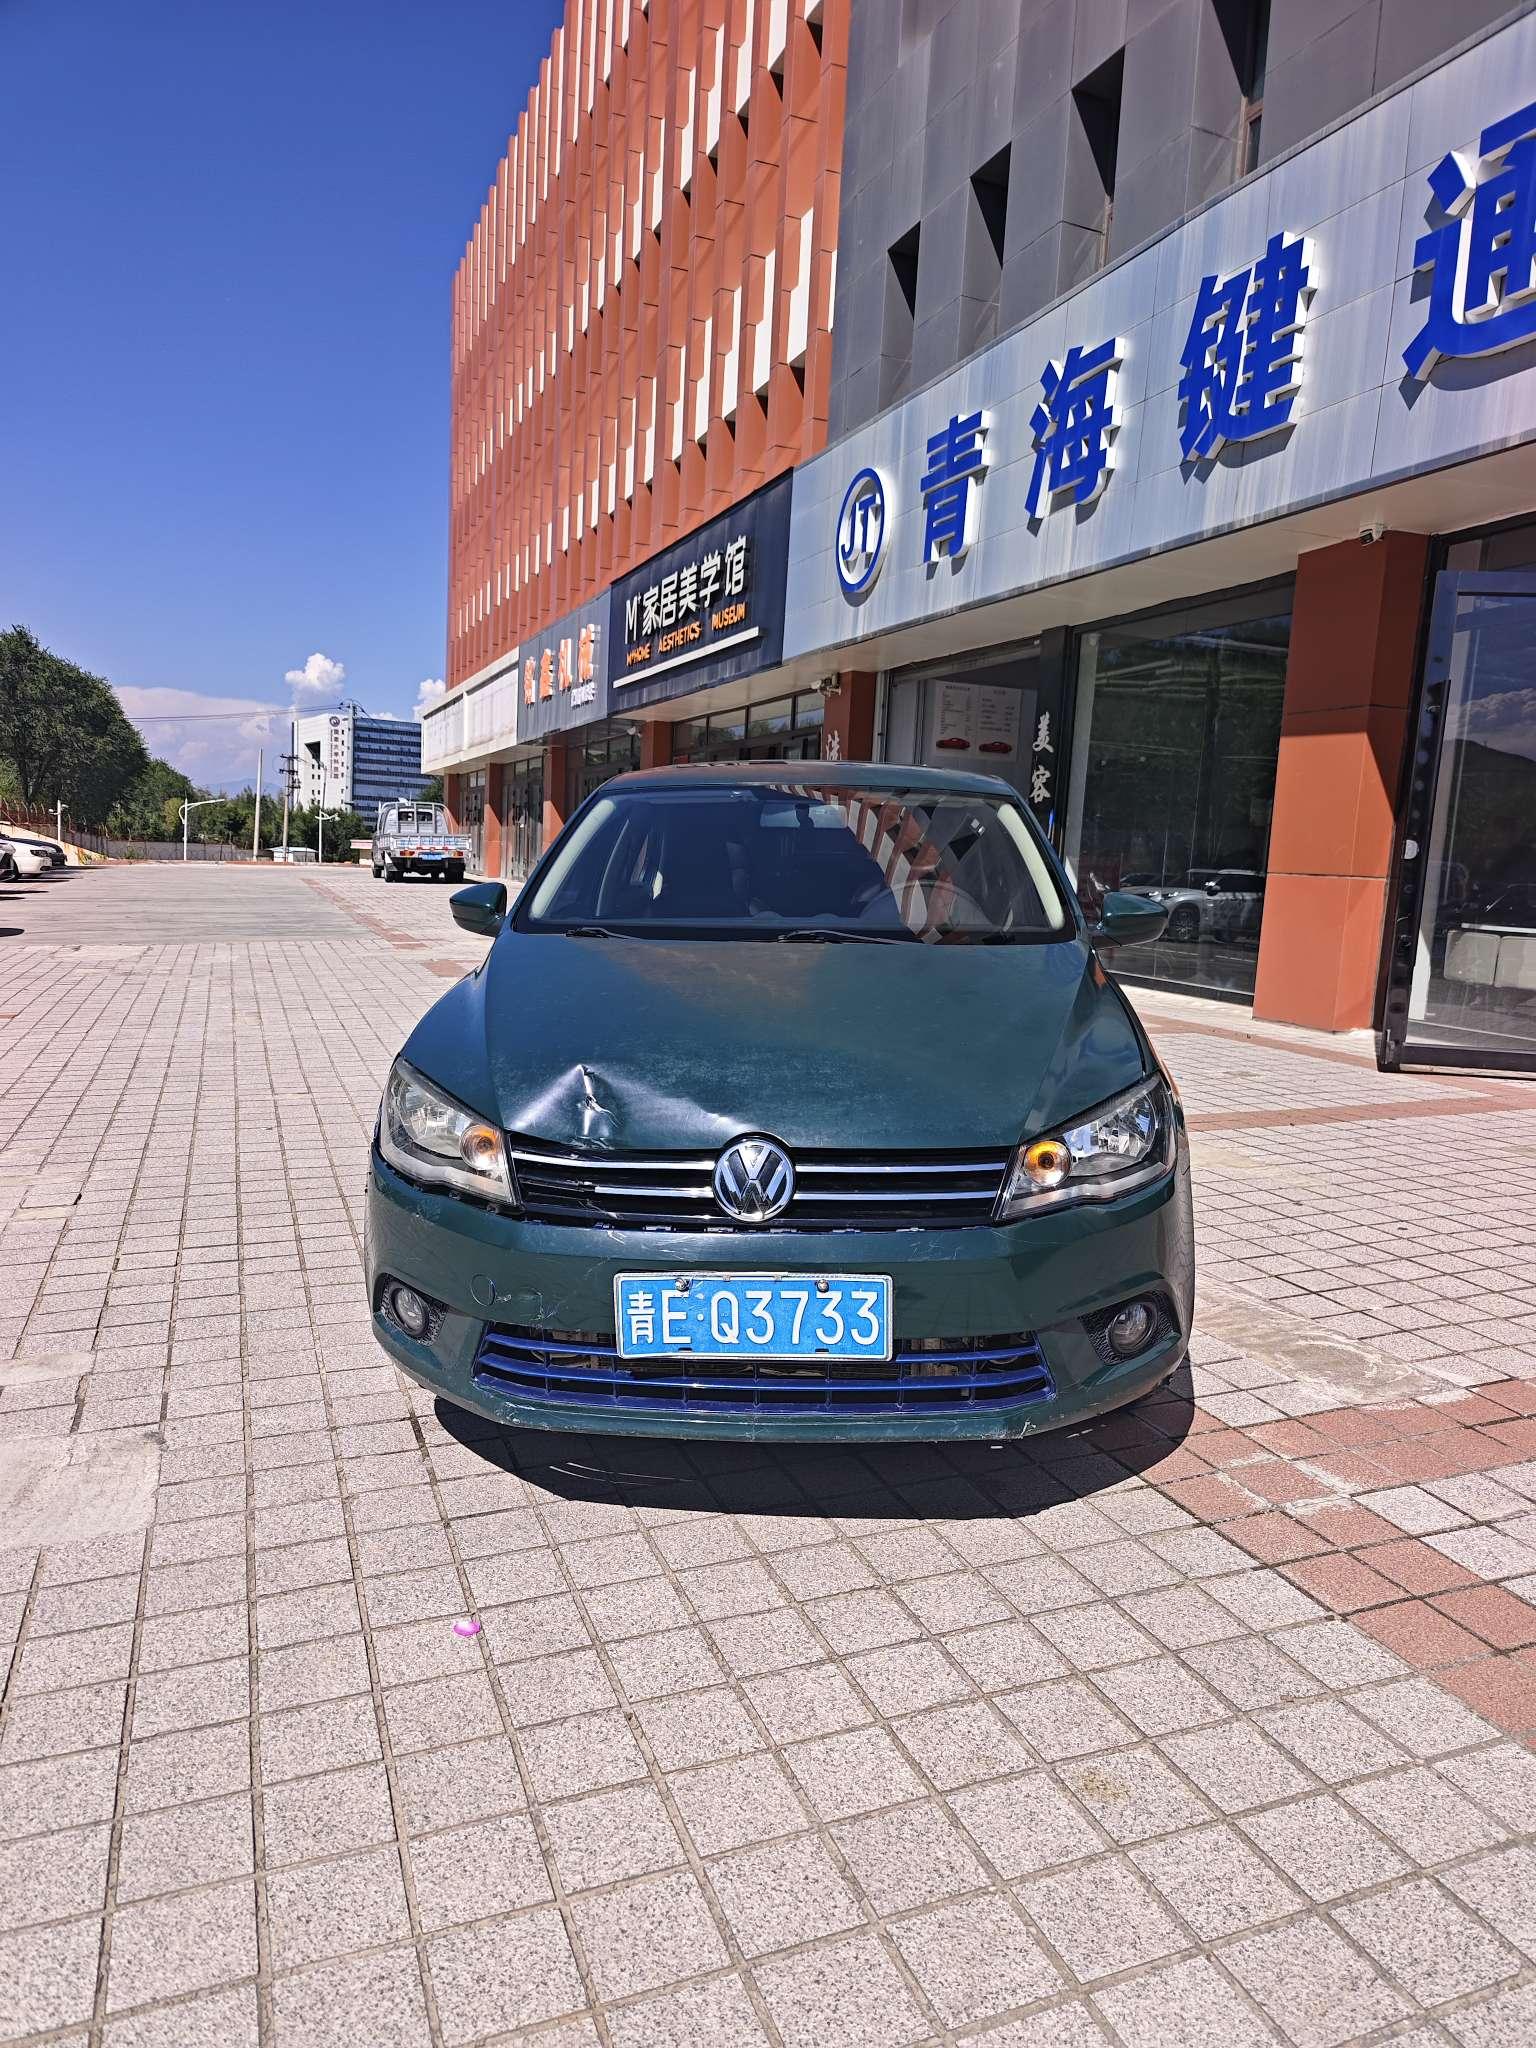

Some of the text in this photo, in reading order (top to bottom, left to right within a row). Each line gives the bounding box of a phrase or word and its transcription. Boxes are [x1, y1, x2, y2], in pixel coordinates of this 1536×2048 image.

[919, 100, 1536, 565] 青海键通
[840, 493, 881, 562] JT
[657, 620, 702, 653] AESTHETICS
[711, 601, 746, 631] MUSEUM
[1031, 711, 1054, 804] 美容
